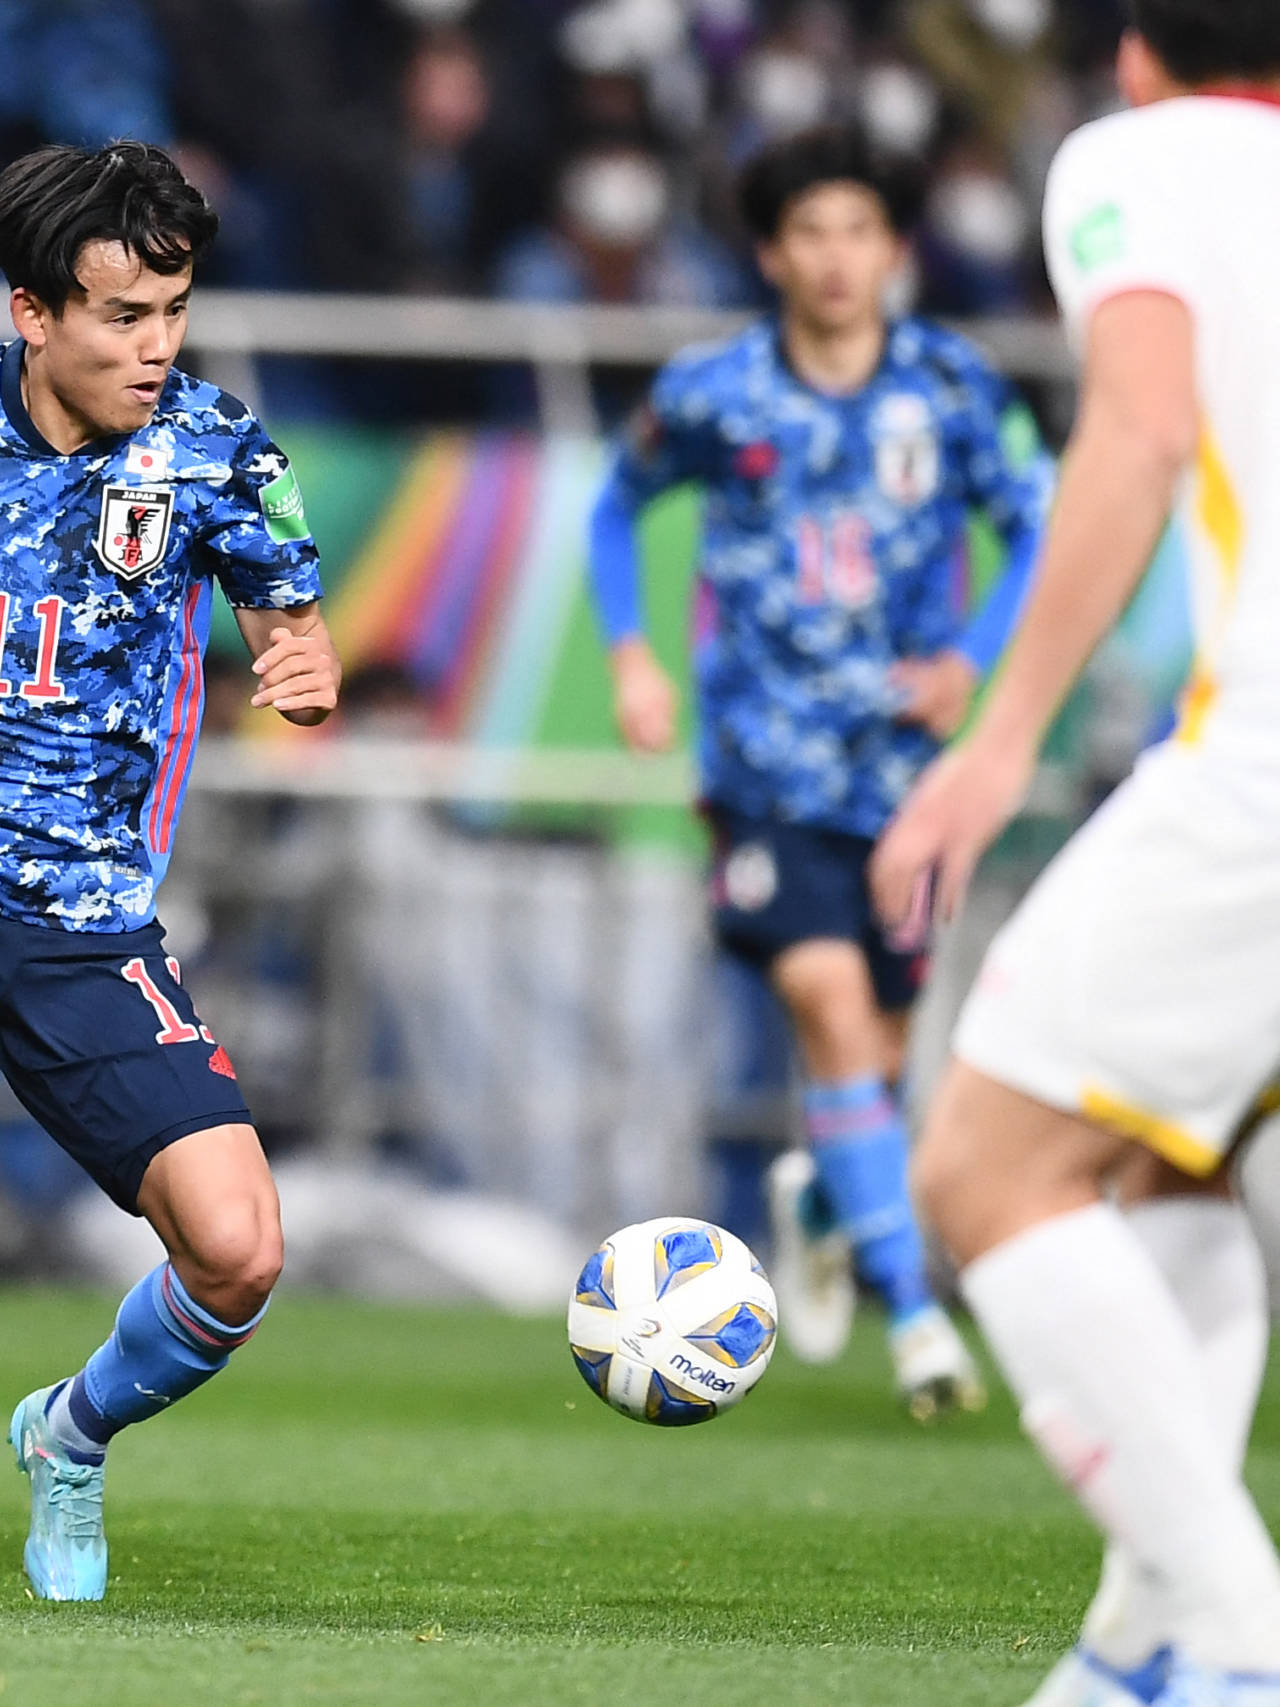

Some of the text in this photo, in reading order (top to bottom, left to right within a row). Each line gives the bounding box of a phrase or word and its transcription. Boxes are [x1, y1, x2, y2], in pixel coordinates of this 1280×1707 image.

[122, 490, 157, 502] JAPAN
[121, 956, 216, 1045] 1
[669, 1354, 736, 1395] molten
